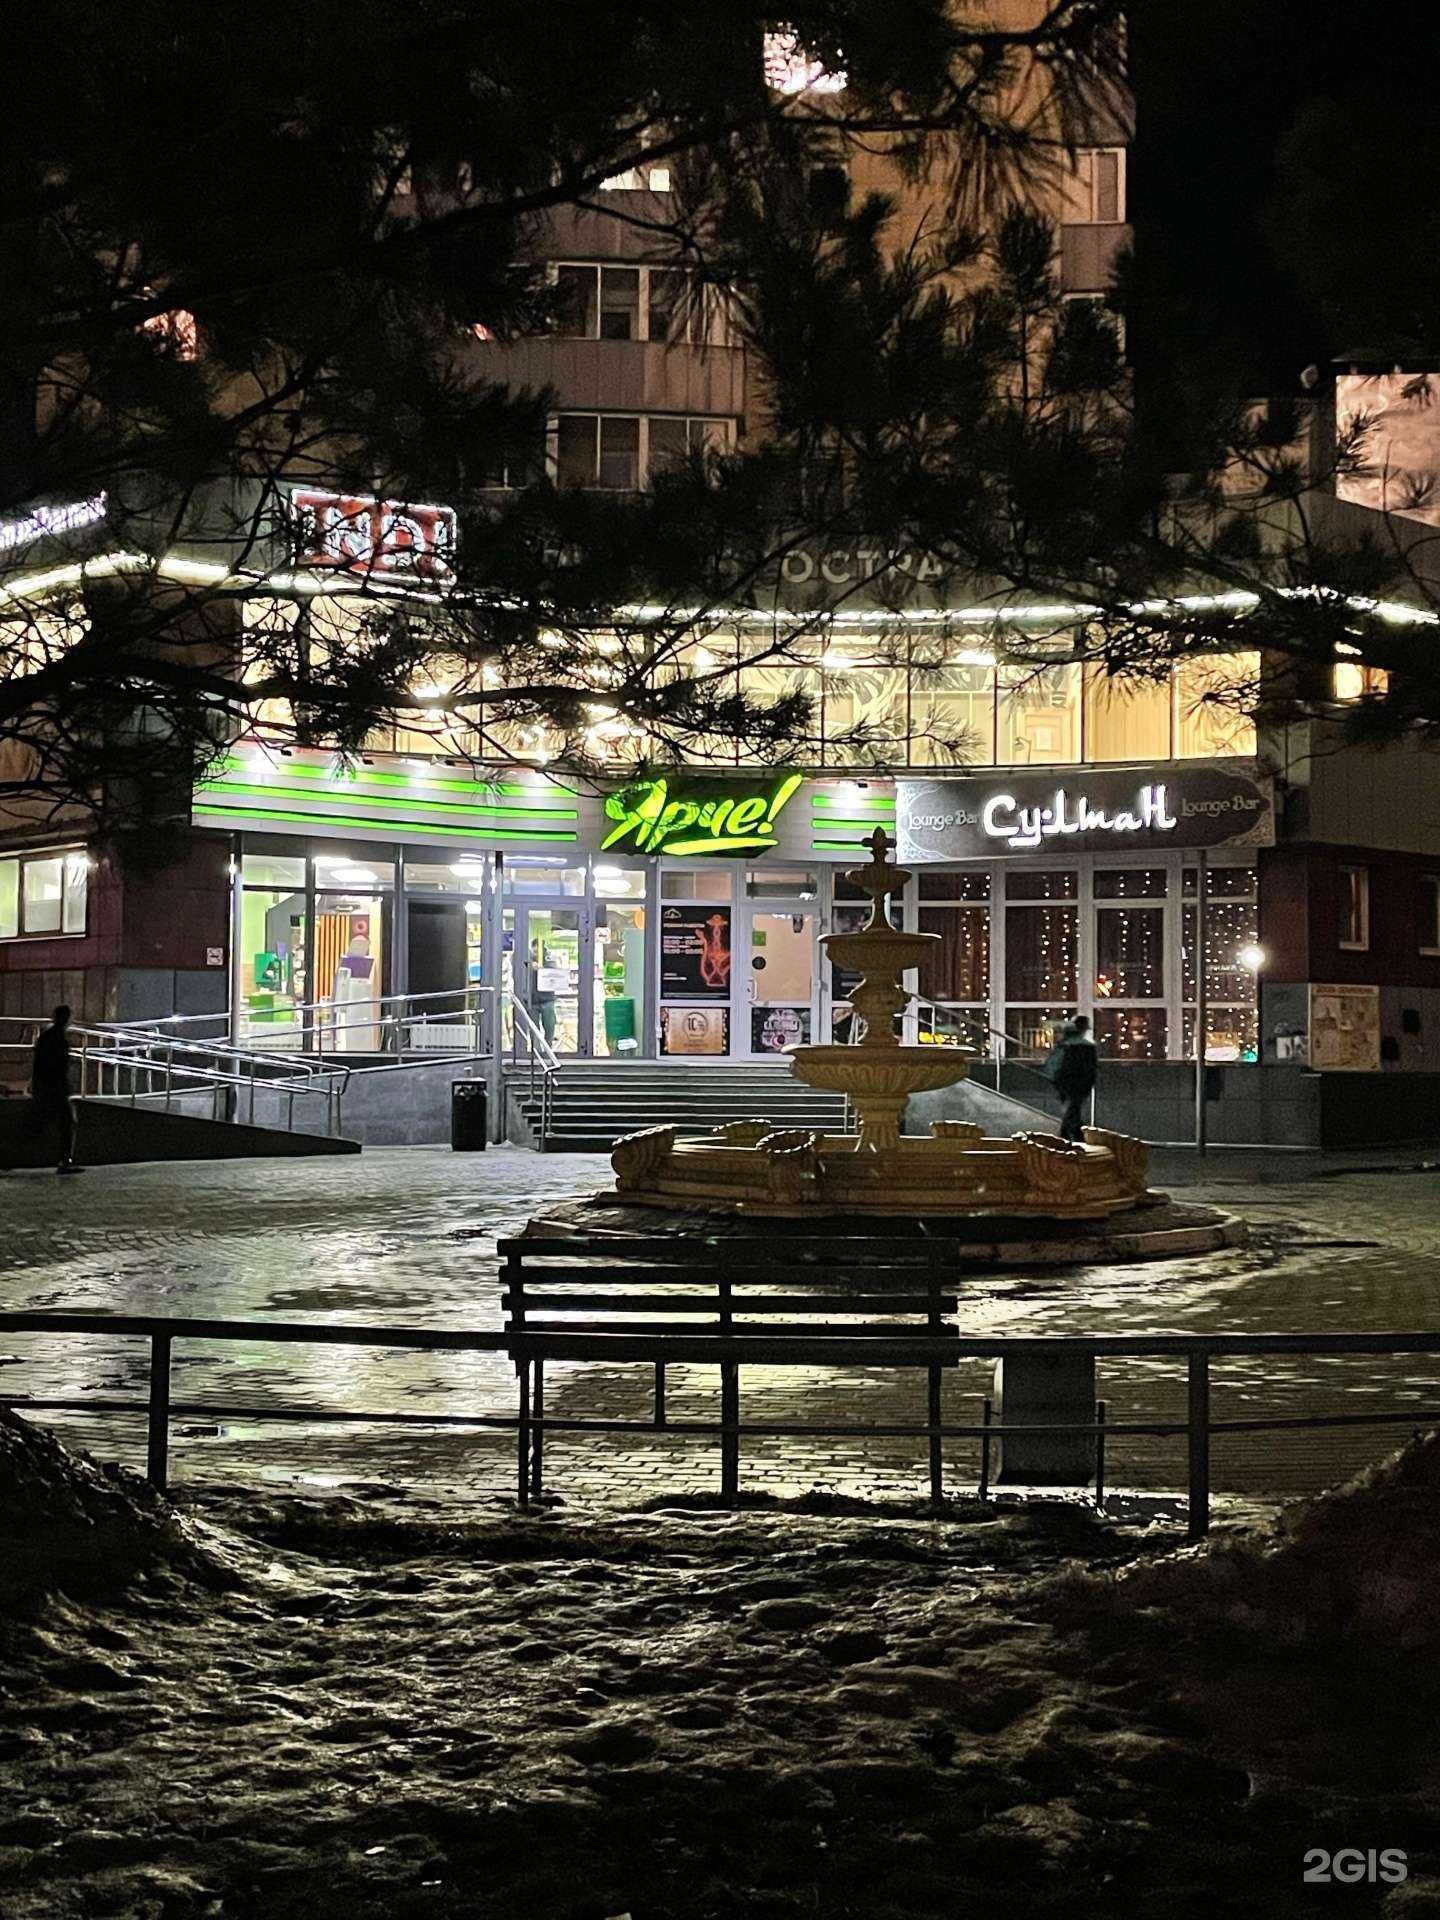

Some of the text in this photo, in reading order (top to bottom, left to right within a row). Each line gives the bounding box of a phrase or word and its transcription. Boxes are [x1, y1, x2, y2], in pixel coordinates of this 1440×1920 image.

[601, 773, 804, 853] Ярче!
[1181, 795, 1260, 818] Lounge Bar
[908, 809, 978, 831] Lounge Bar
